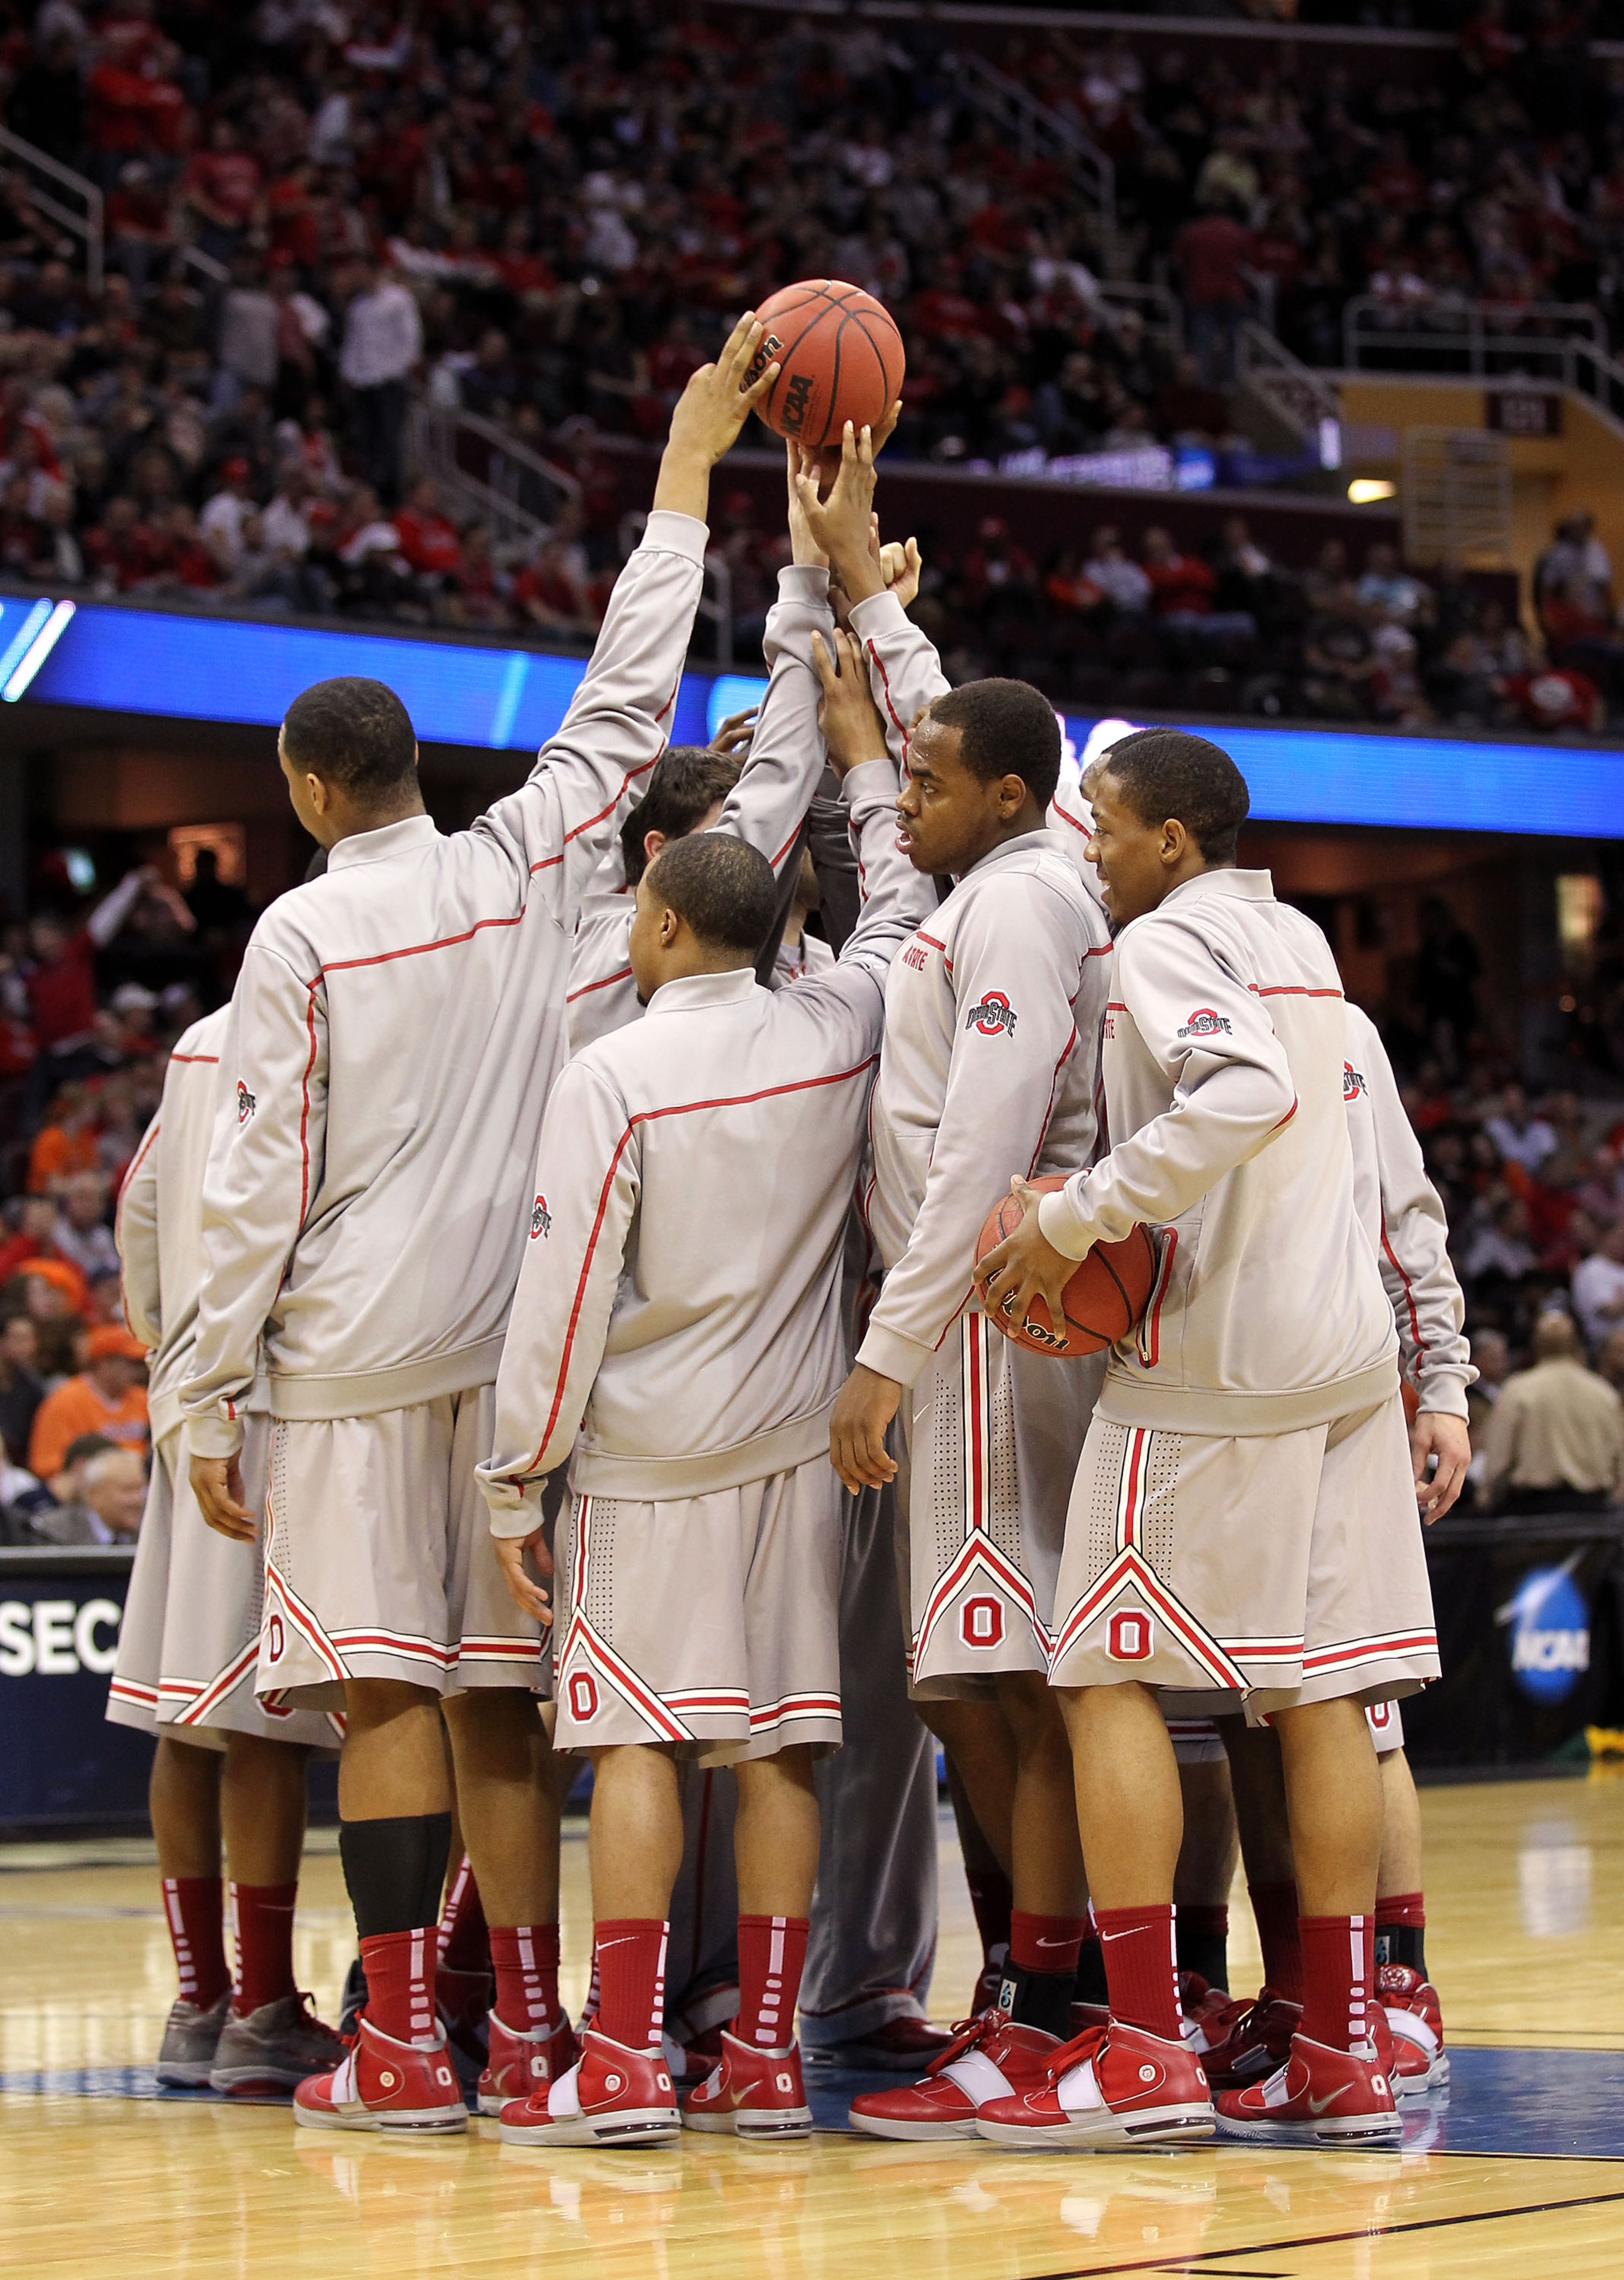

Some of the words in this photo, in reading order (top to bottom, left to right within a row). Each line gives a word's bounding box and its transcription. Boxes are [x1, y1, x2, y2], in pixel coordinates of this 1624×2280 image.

[781, 374, 813, 437] NCAA
[0, 1600, 120, 1676] SEC
[962, 1596, 1004, 1648] O
[1108, 1610, 1152, 1660] O
[568, 1671, 599, 1723] O
[436, 2066, 452, 2086] O
[656, 2072, 672, 2091] O
[777, 2073, 793, 2093] O
[1371, 2074, 1388, 2096] O
